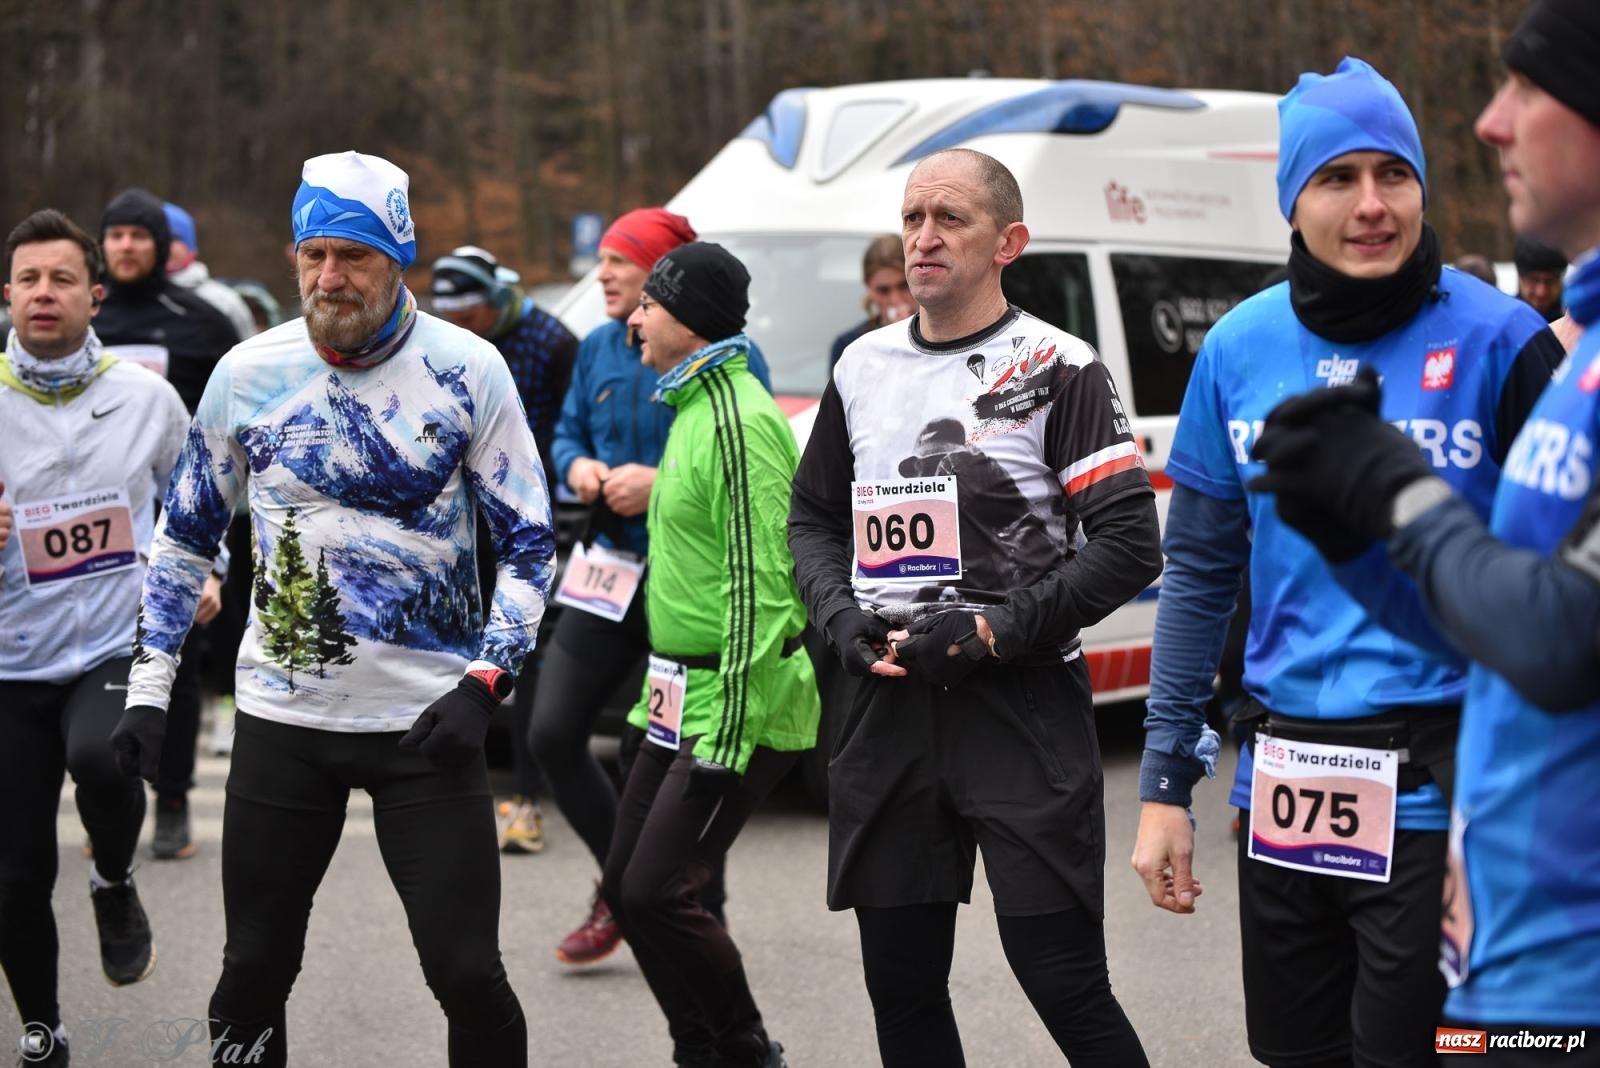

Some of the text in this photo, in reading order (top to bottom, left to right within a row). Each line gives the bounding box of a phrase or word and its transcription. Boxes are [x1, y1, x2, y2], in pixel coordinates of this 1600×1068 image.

[856, 481, 946, 497] BIEG Twardziela
[24, 492, 119, 517] BIEG Twardziela
[44, 518, 111, 558] 087
[866, 512, 935, 552] 060
[584, 565, 617, 594] 114
[907, 563, 937, 571] Racibórz
[651, 662, 679, 676] dziela
[648, 684, 664, 719] 2
[1263, 740, 1285, 760] BIEG
[1288, 749, 1382, 771] Twardziela
[1272, 784, 1360, 838] 075
[1323, 853, 1362, 867] Racibórz
